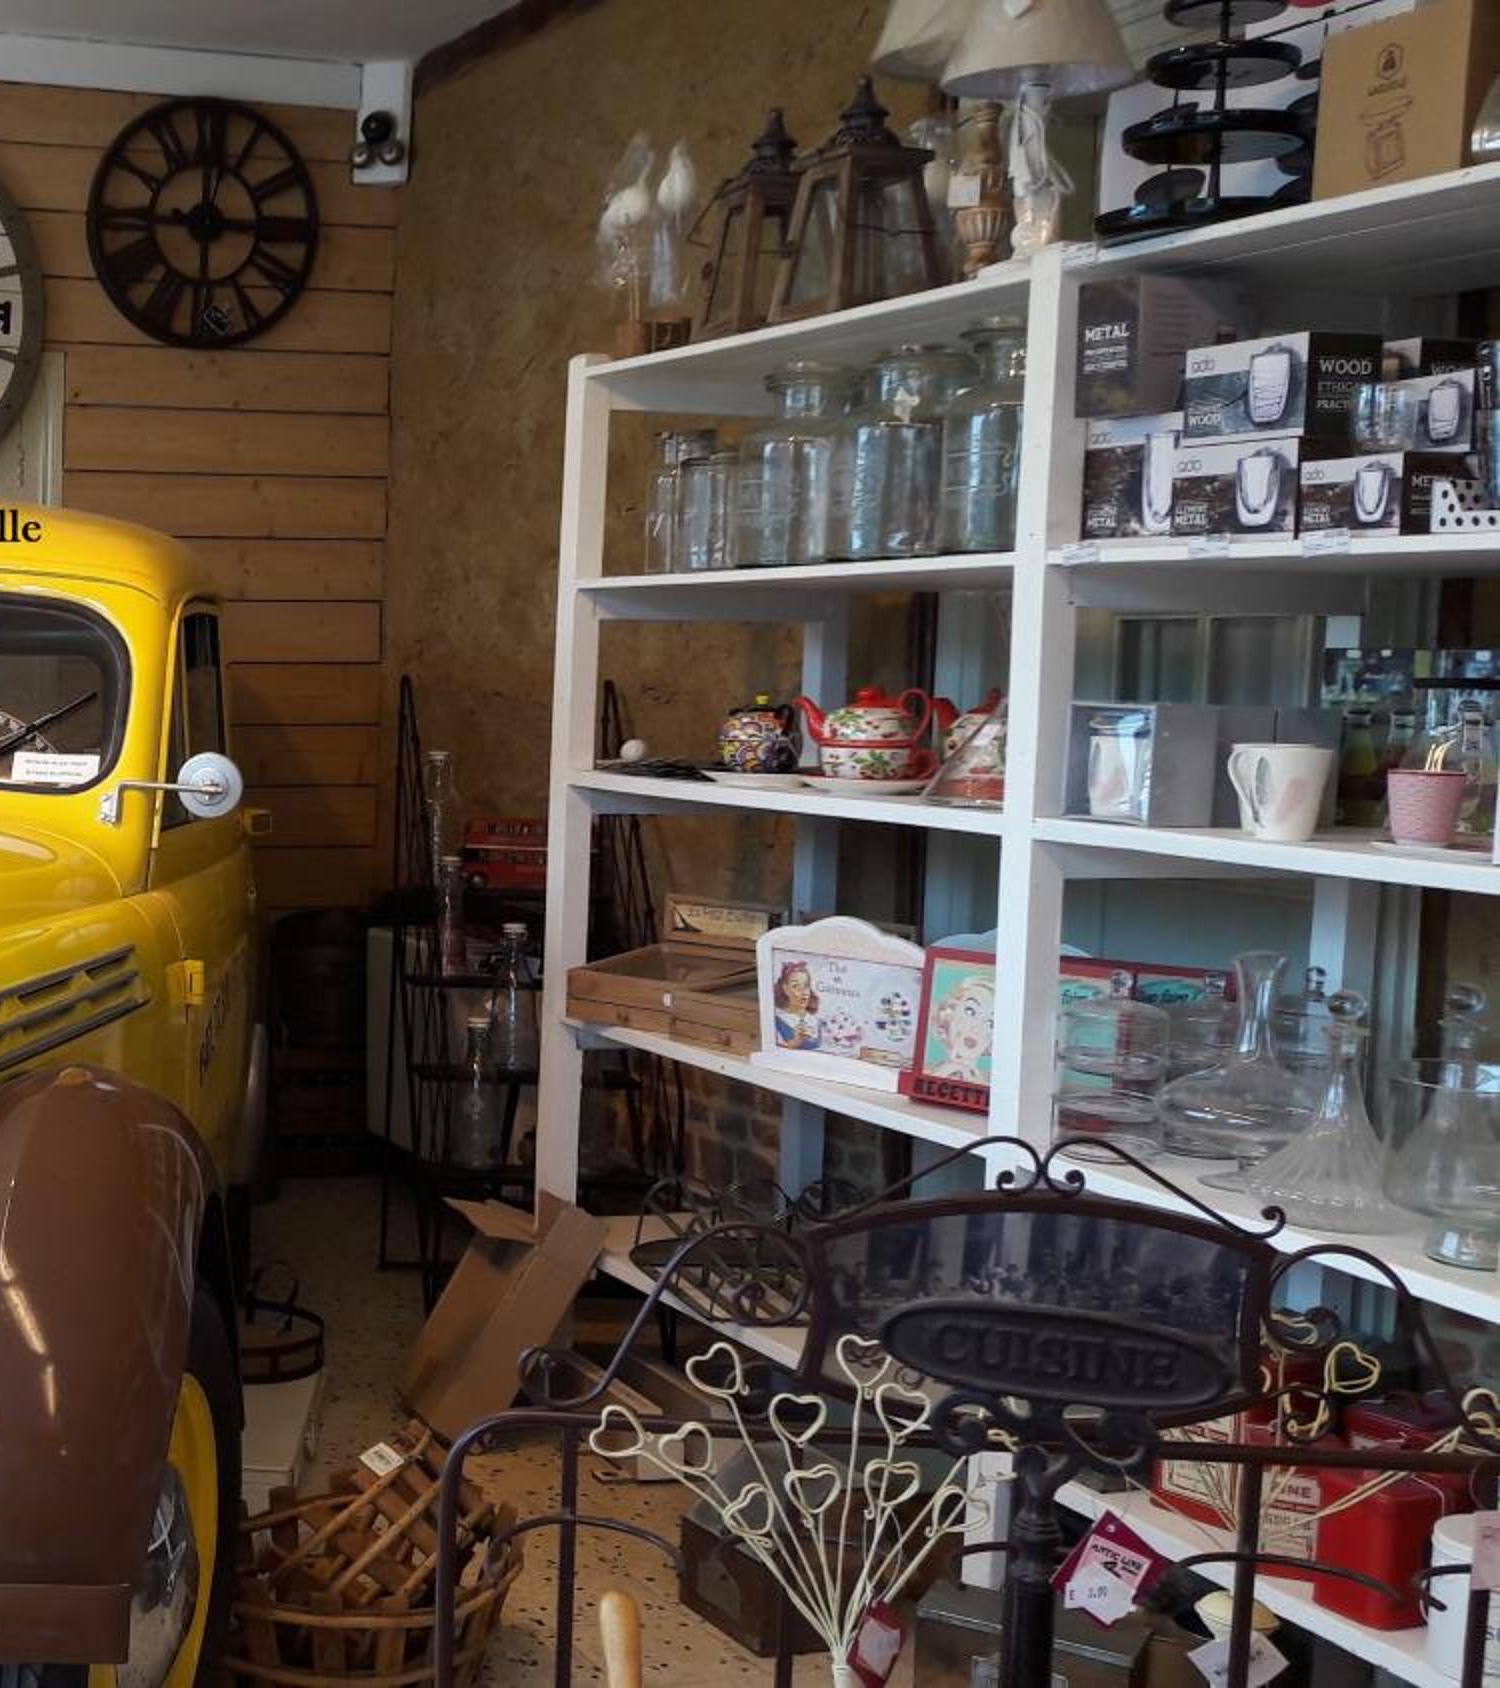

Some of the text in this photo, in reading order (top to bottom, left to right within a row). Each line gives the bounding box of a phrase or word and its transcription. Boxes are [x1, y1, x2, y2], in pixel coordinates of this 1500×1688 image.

[1085, 323, 1130, 342] METAL
[1320, 359, 1372, 375] WOOD
[935, 1321, 1178, 1387] CUISINE
